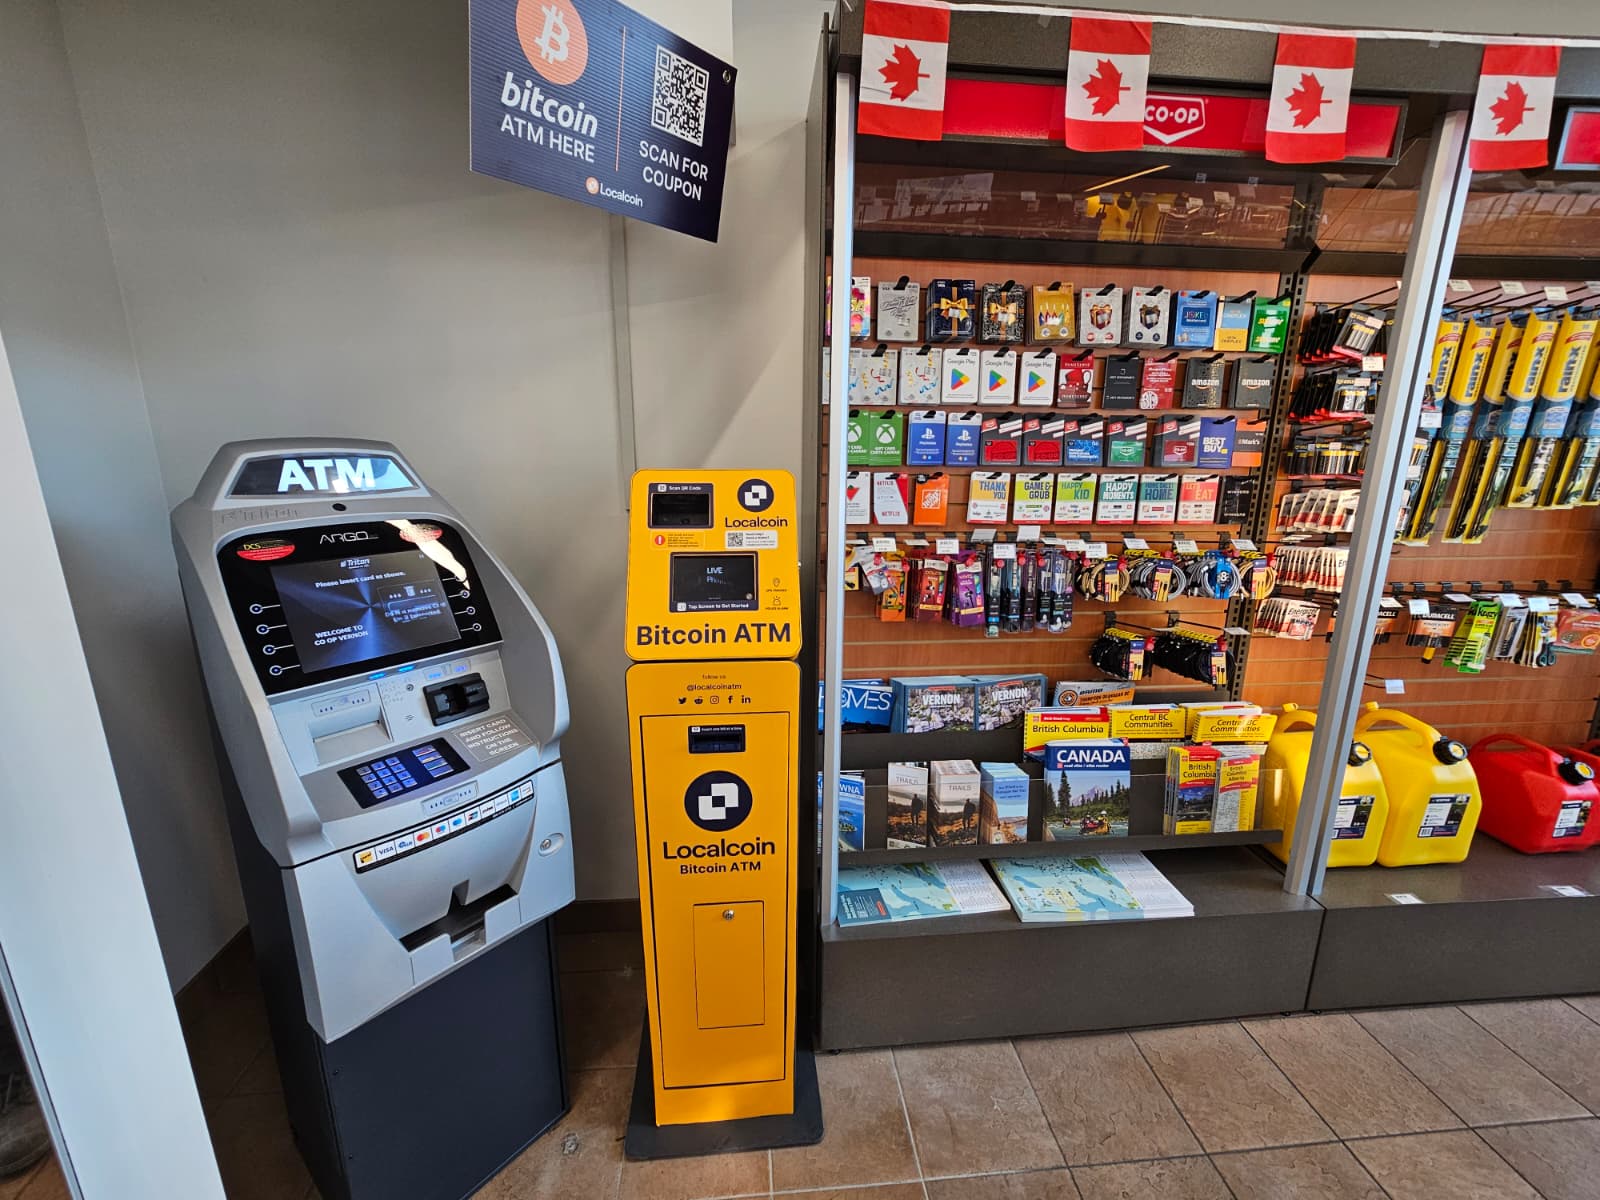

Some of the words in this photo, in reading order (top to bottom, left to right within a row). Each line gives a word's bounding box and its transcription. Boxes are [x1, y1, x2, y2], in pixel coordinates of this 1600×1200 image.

[501, 71, 598, 138] bitcoin
[501, 114, 543, 145] ATM
[550, 134, 595, 163] HERE
[639, 140, 679, 170] SCAN
[682, 157, 709, 182] FOR
[642, 166, 701, 201] COUPON
[599, 182, 643, 208] Localcoin
[947, 358, 965, 366] Google
[966, 358, 976, 366] Play
[1191, 379, 1219, 387] amazon
[1241, 379, 1270, 387] amazon
[1203, 437, 1226, 445] BEST
[1203, 445, 1222, 453] BUY
[277, 458, 376, 493] ATM
[979, 481, 1007, 491] THANK
[1024, 482, 1044, 490] GAME
[1061, 482, 1083, 490] HAPPY
[1105, 482, 1133, 492] HAPPY
[993, 491, 1006, 500] YOU
[1029, 491, 1050, 500] GRUB
[1074, 489, 1091, 500] KID
[1103, 491, 1134, 500] MOMENTS
[1145, 489, 1173, 500] HOME
[1195, 489, 1213, 500] EAT
[725, 516, 788, 528] Localcoin
[319, 531, 369, 544] ARGO
[347, 558, 370, 567] Triton
[315, 580, 338, 588] Please
[360, 574, 374, 582] card
[315, 626, 352, 638] WELCOME
[353, 624, 363, 632] TO
[637, 623, 727, 646] Bitcoin
[734, 622, 791, 643] ATM
[314, 637, 326, 646] CO
[327, 636, 337, 644] OP
[339, 631, 369, 642] VERNON
[687, 683, 742, 691] @localcoinatm
[991, 687, 1028, 701] VERNON
[923, 694, 961, 706] VERNON
[1129, 713, 1156, 722] Central
[1157, 713, 1169, 722] BC
[460, 725, 485, 737] INSERT
[486, 718, 507, 730] CARD
[1032, 724, 1060, 734] British
[1062, 724, 1104, 734] Columbia
[1124, 720, 1174, 730] Communities
[465, 734, 481, 743] AND
[481, 724, 512, 739] FOLLOW
[467, 728, 519, 750] INSTRUCTIONS
[485, 741, 497, 750] ON
[498, 737, 513, 747] THE
[489, 741, 519, 755] SCREEN
[1056, 750, 1126, 763] CANADA
[1188, 763, 1211, 771] British
[896, 776, 919, 785] TRAILS
[1183, 771, 1216, 779] Columbia
[379, 846, 394, 855] VISA
[663, 837, 775, 860] Localcoin
[680, 861, 727, 875] Bitcoin
[730, 861, 761, 872] ATM
